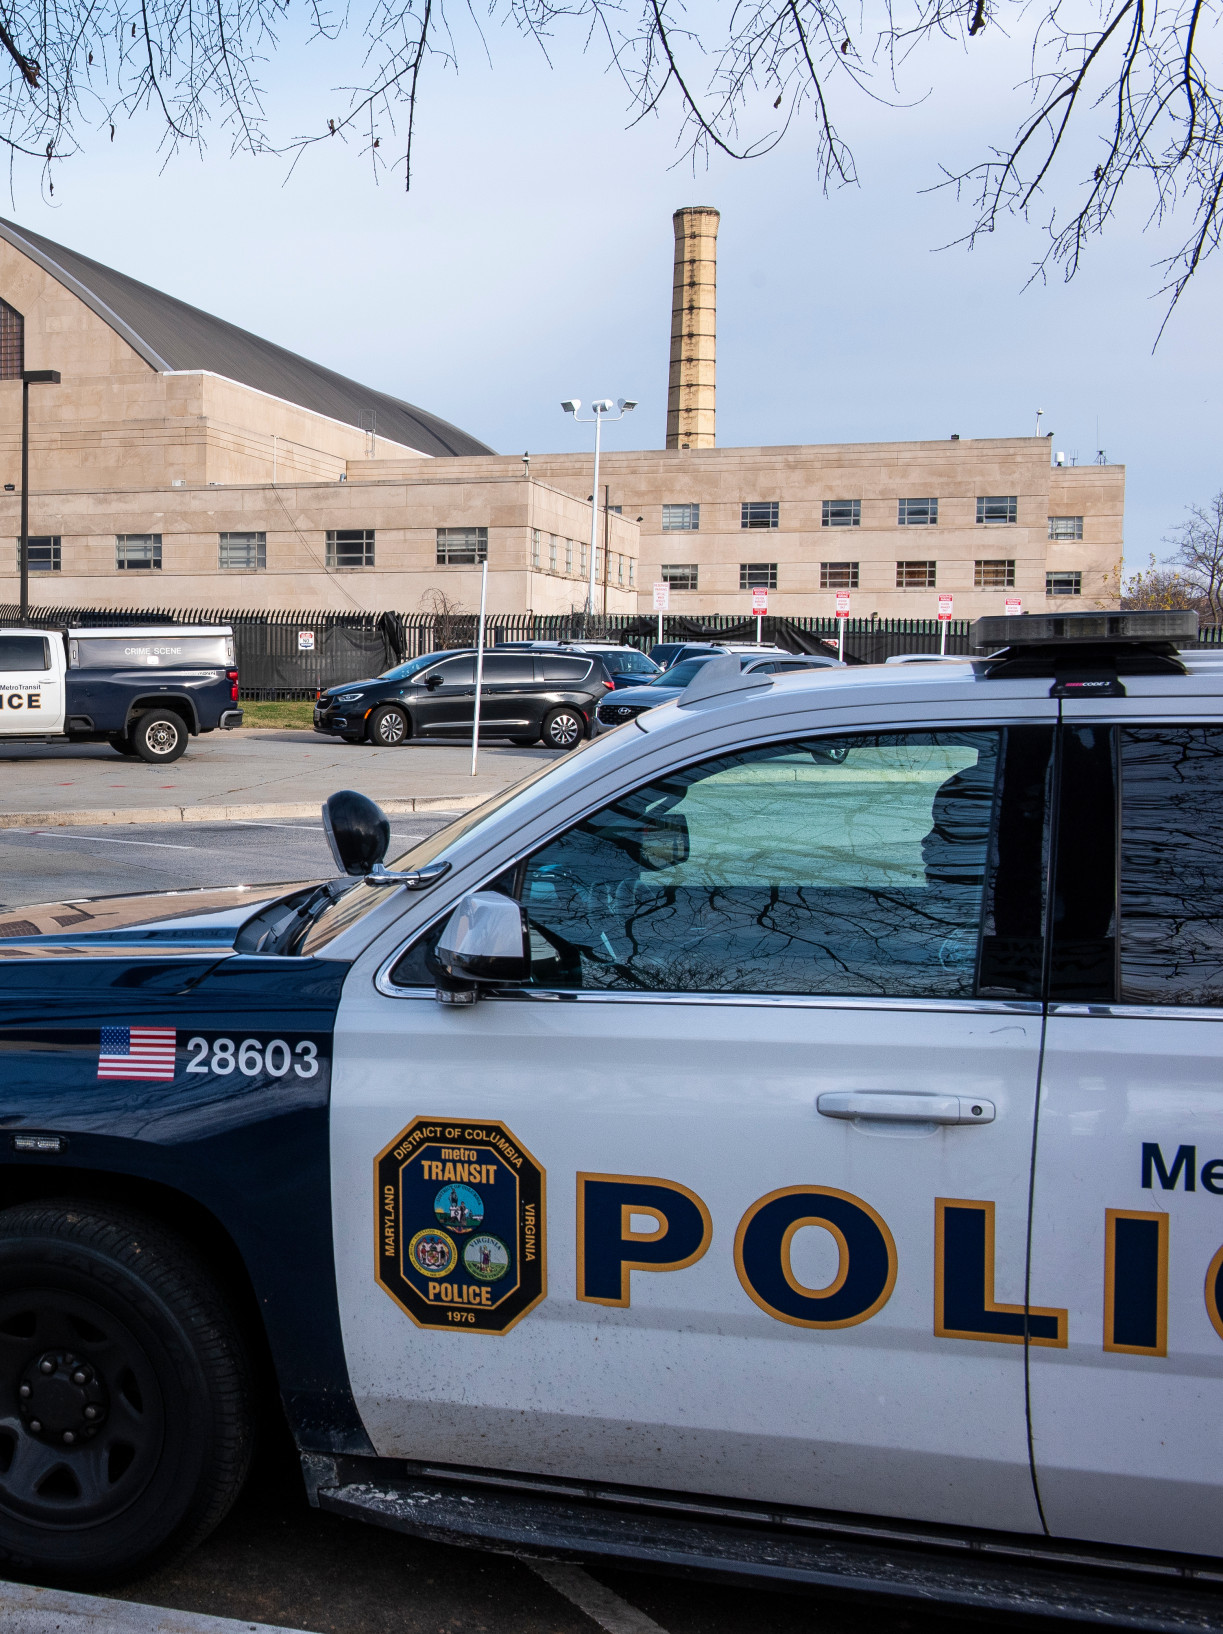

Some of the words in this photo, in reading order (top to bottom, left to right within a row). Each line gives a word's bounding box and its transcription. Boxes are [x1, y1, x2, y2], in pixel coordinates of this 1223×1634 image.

[185, 1036, 319, 1078] 28603
[393, 1127, 442, 1160] DISTRICT
[445, 1128, 461, 1138] OF
[464, 1129, 524, 1169] COLUMBIA
[441, 1147, 477, 1161] metro
[421, 1160, 497, 1184] TRANSIT
[384, 1185, 395, 1256] MARYLAND
[525, 1203, 536, 1262] VIRGINIA
[469, 1237, 501, 1250] VIRGINIA
[576, 1171, 1223, 1358] POLI
[428, 1281, 492, 1305] POLICE
[446, 1311, 476, 1323] 1976
